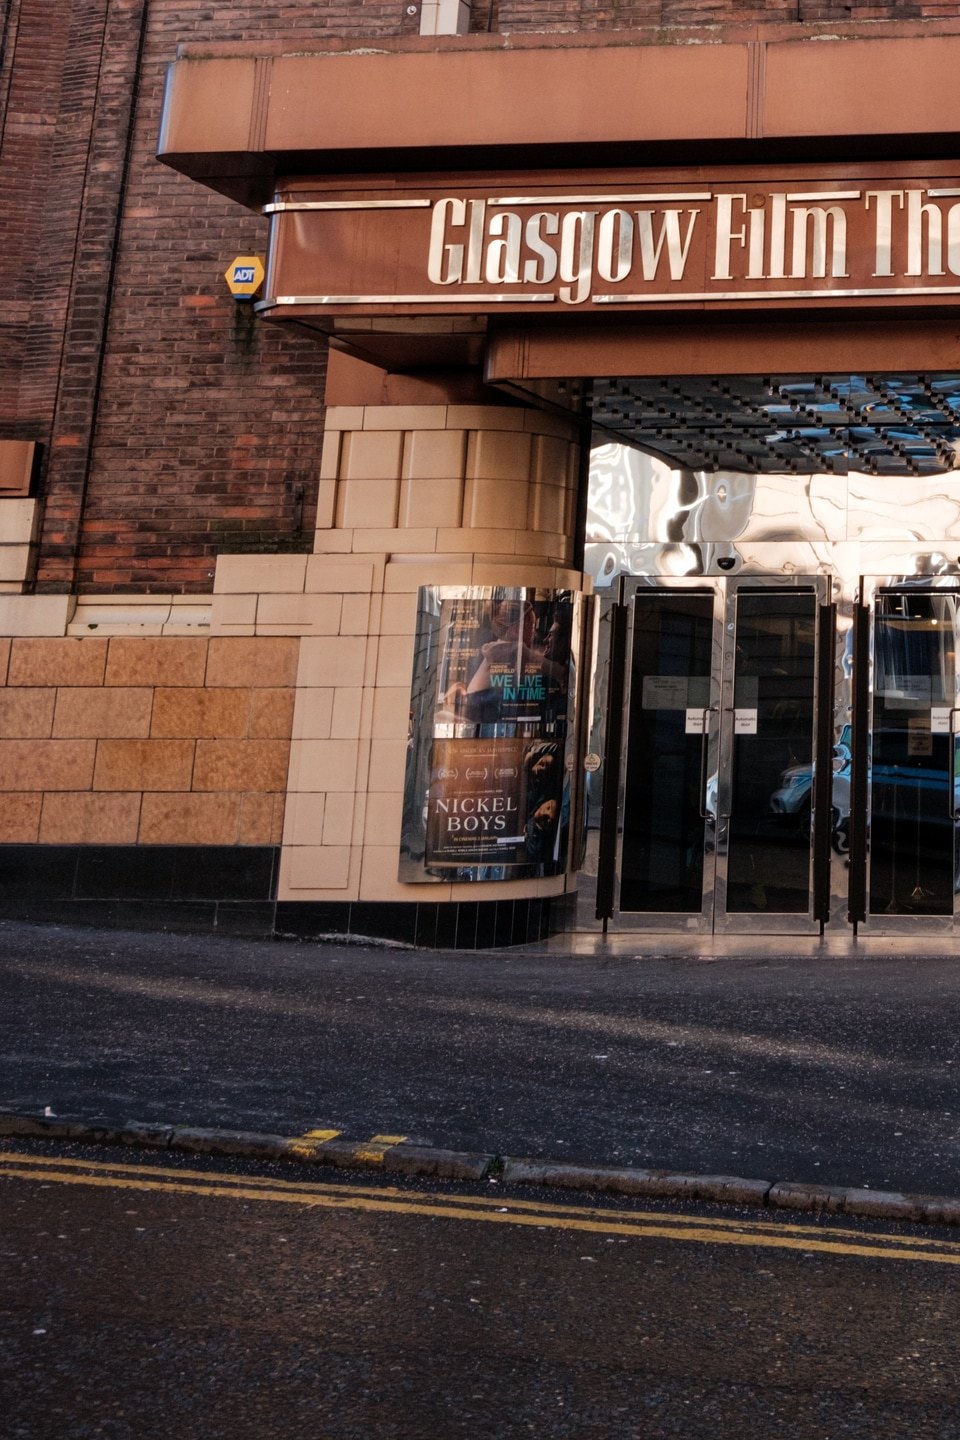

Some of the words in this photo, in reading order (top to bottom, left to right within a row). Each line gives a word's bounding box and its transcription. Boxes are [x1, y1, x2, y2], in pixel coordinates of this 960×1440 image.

[427, 194, 703, 303] Glasgow
[711, 194, 849, 280] Film
[234, 269, 255, 281] ADT
[490, 675, 513, 687] WE
[518, 675, 543, 687] LIVE
[503, 688, 515, 700] IN
[519, 688, 546, 700] TIME
[435, 797, 517, 814] NICKEL
[447, 815, 506, 832] BOYS
